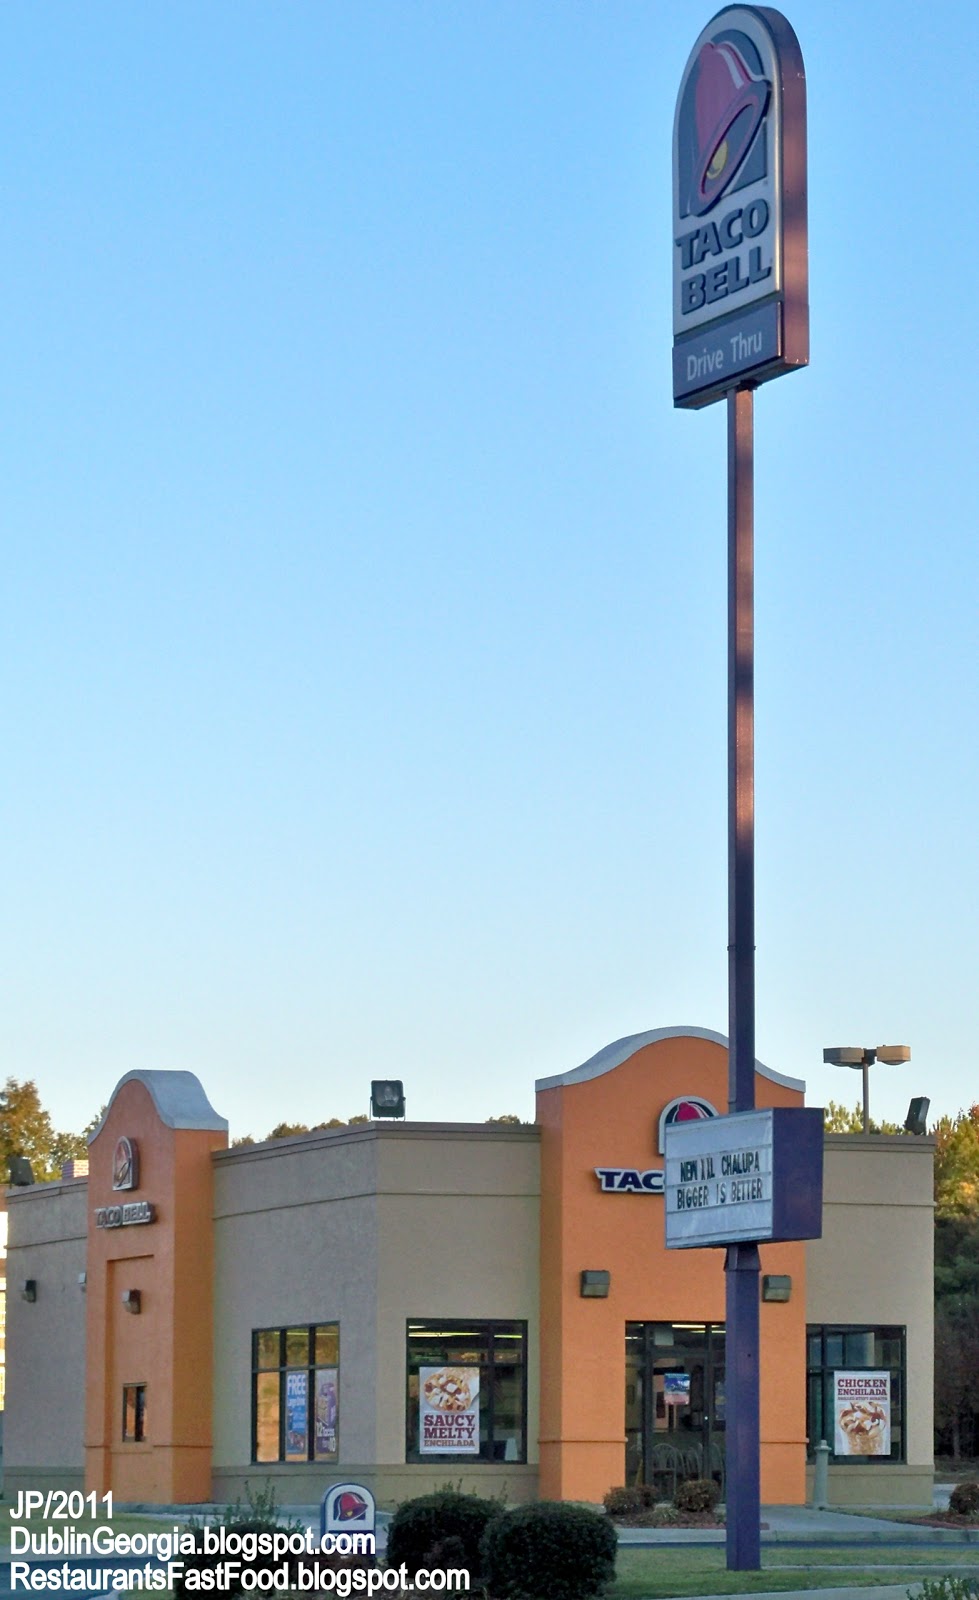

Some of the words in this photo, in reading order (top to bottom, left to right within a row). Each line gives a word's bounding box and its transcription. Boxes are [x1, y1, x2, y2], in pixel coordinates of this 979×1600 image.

[675, 198, 770, 271] TACO
[681, 246, 773, 316] BELL
[687, 347, 724, 381] Drive
[730, 331, 763, 364] Thru
[680, 1159, 698, 1182] NEW
[721, 1151, 760, 1176] CHALUPA
[598, 1171, 665, 1190] TAC
[677, 1185, 709, 1210] BIGGER
[716, 1182, 726, 1204] IS
[731, 1178, 763, 1202] BETTER
[95, 1207, 122, 1228] TACO
[837, 1379, 887, 1388] CHICKEN
[837, 1388, 888, 1396] ENCHILADA
[424, 1427, 475, 1439] MELTY
[424, 1439, 475, 1447] ENCHILADA
